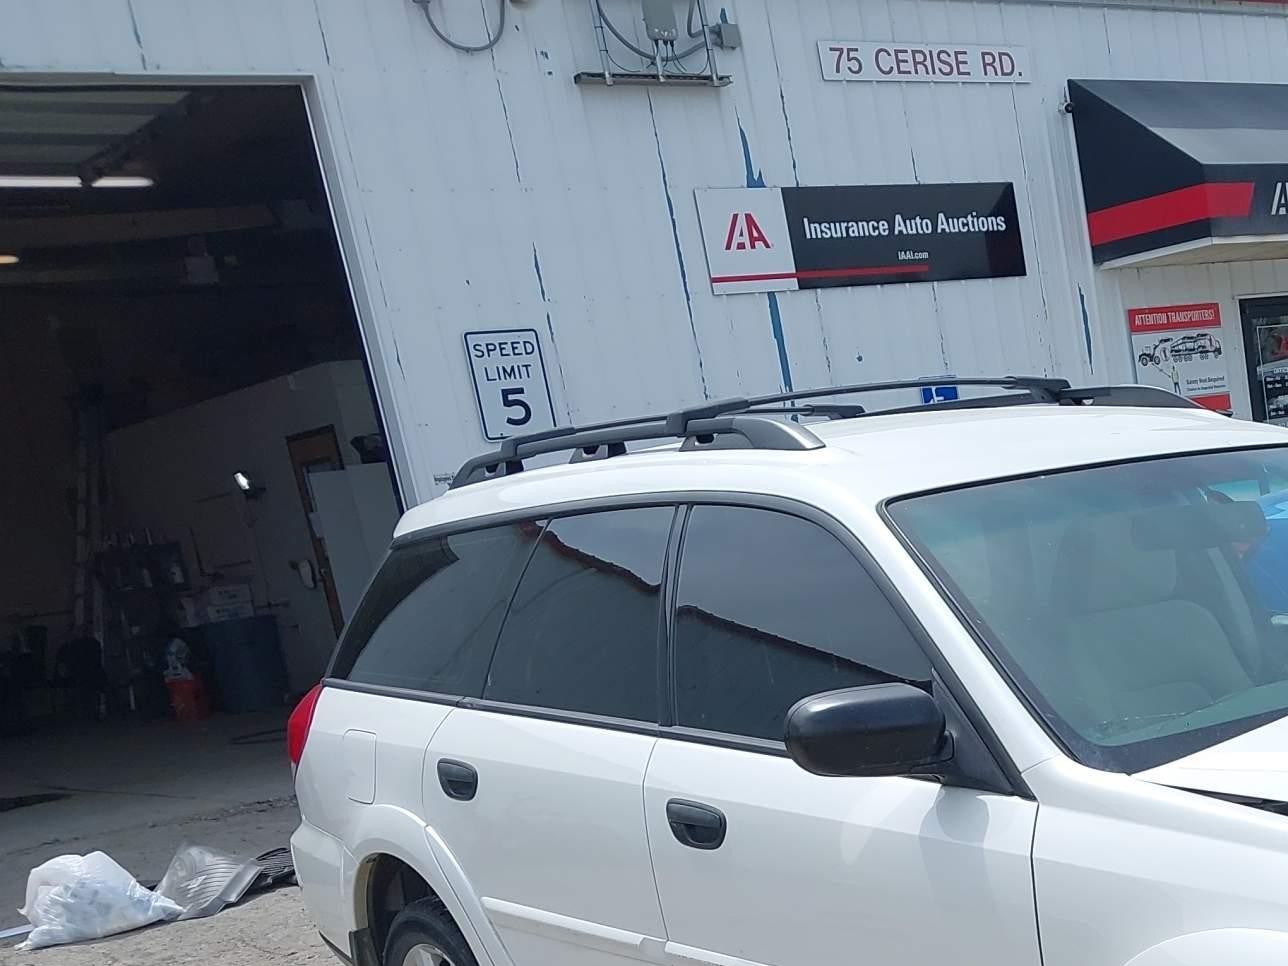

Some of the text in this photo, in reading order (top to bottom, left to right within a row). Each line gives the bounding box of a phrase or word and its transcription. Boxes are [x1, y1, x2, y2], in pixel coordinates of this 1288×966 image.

[829, 47, 1023, 77] 75 CERISE RD.
[803, 211, 1007, 239] Insurance Auto Auctions
[1135, 313, 1168, 326] ATTENTION
[473, 341, 535, 358] SPEED
[484, 364, 532, 381] LIMIT
[501, 387, 532, 426] 5
